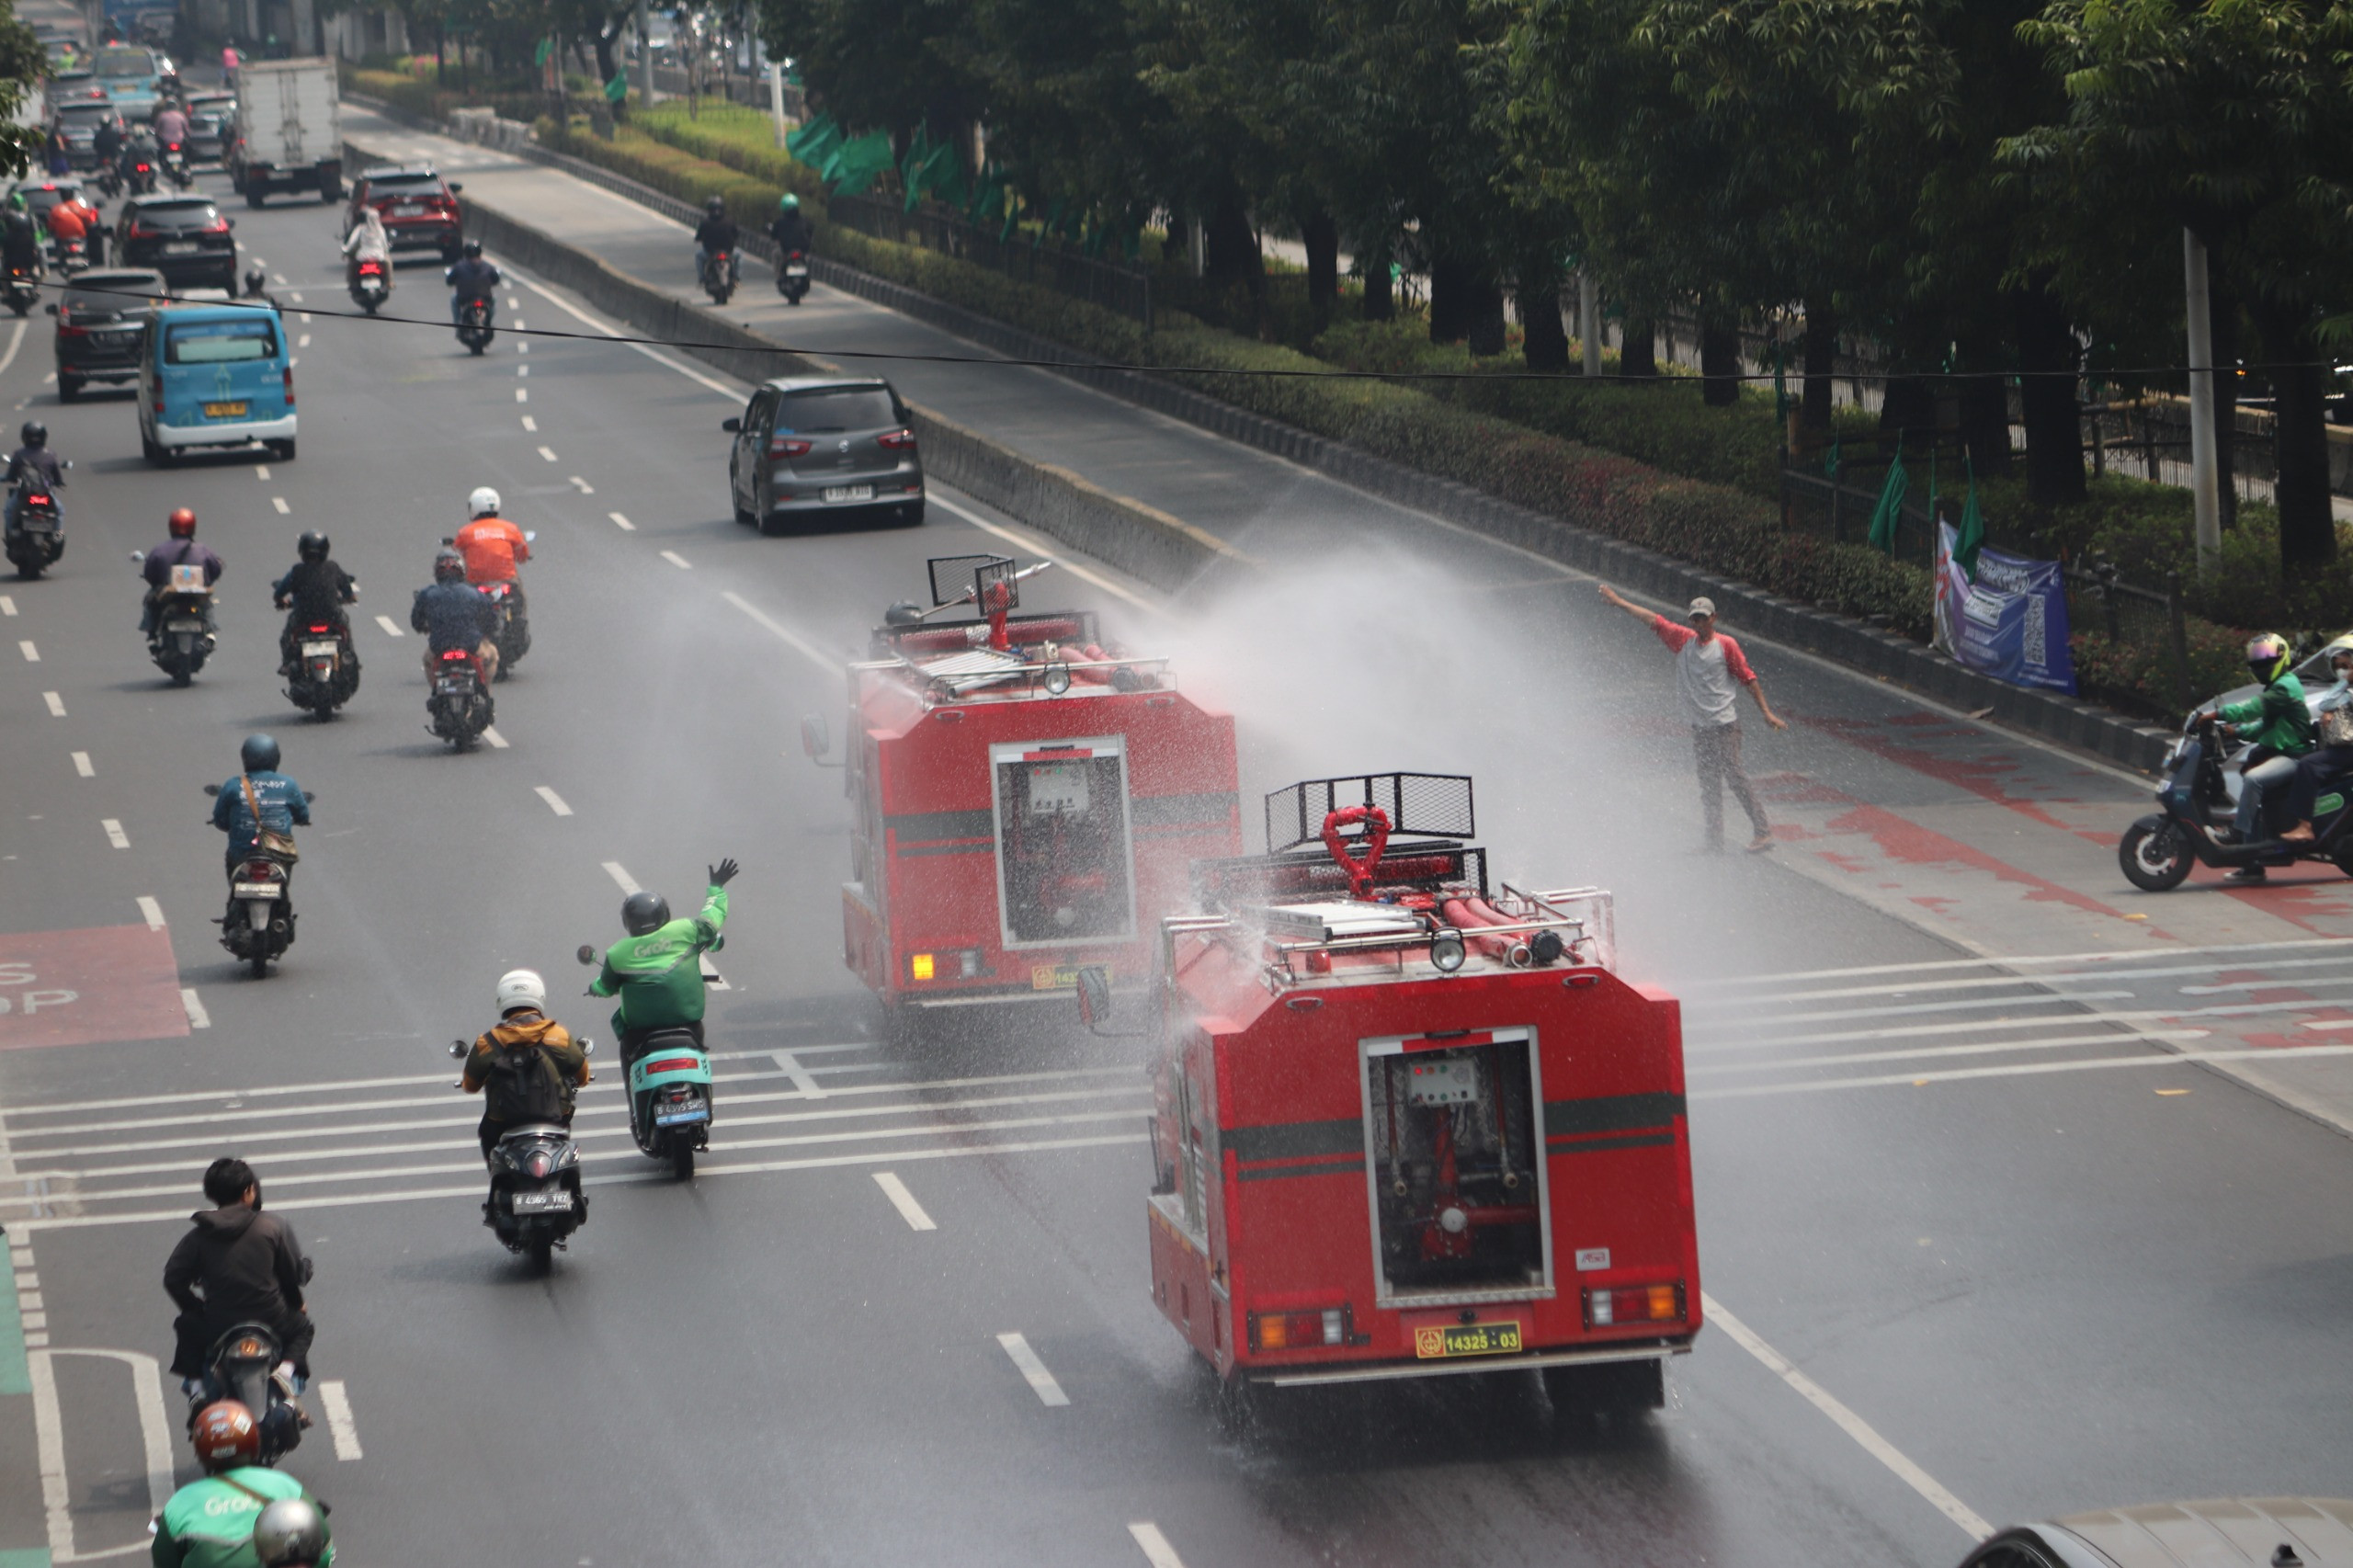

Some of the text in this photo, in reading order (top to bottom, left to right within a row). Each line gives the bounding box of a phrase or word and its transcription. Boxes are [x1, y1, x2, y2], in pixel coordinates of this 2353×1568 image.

[634, 938, 672, 958] Grab
[1447, 1335, 1488, 1351] 14325
[1500, 1332, 1518, 1348] 03
